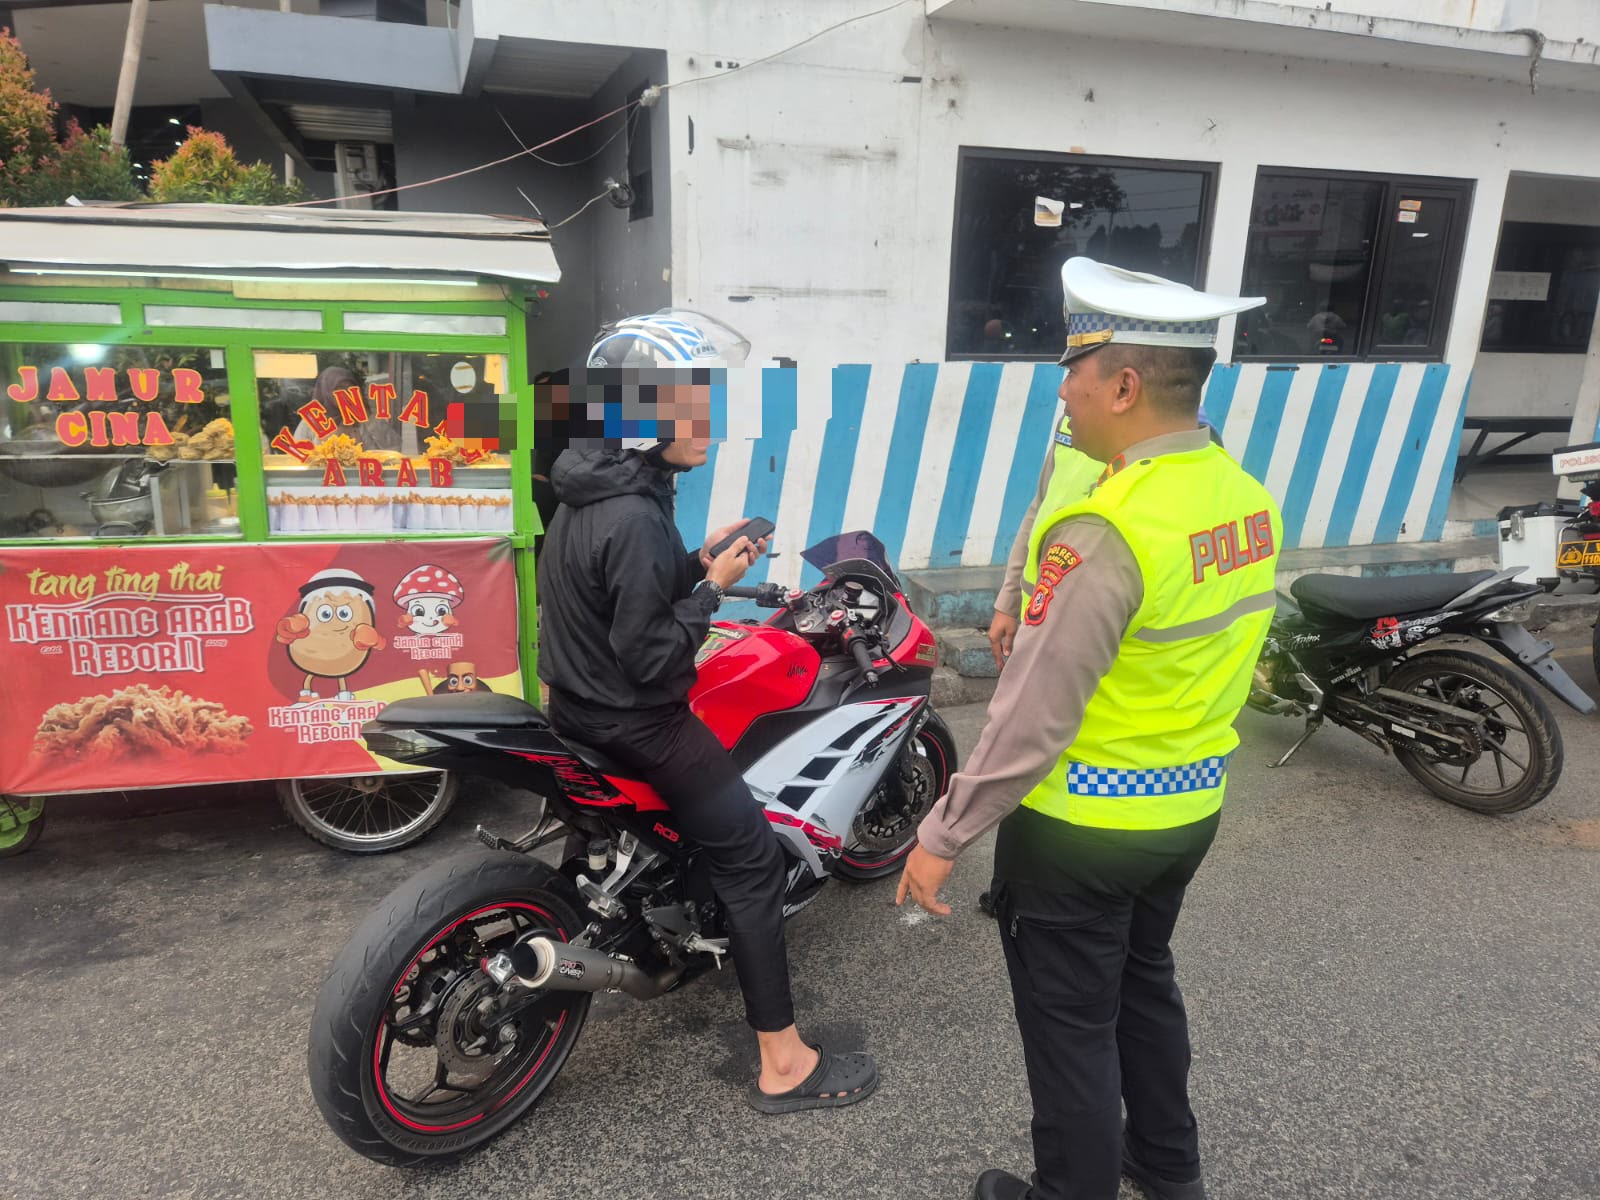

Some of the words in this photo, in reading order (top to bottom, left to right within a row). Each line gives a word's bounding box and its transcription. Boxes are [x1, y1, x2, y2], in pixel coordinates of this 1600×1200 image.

[7, 366, 204, 403] JAMUR
[56, 411, 175, 447] CINA
[271, 383, 492, 464] KENTA
[323, 458, 454, 487] ARAB
[1189, 509, 1275, 585] POLIS
[26, 568, 97, 599] tang
[104, 565, 161, 602] ting
[168, 561, 225, 592] thai
[6, 604, 158, 643] KENTANG
[165, 597, 254, 636] ARAB
[68, 635, 204, 676] REBORN
[411, 647, 452, 660] REBORN
[268, 706, 342, 728] KENTANG
[298, 721, 364, 744] REBORN
[653, 822, 679, 842] RCB
